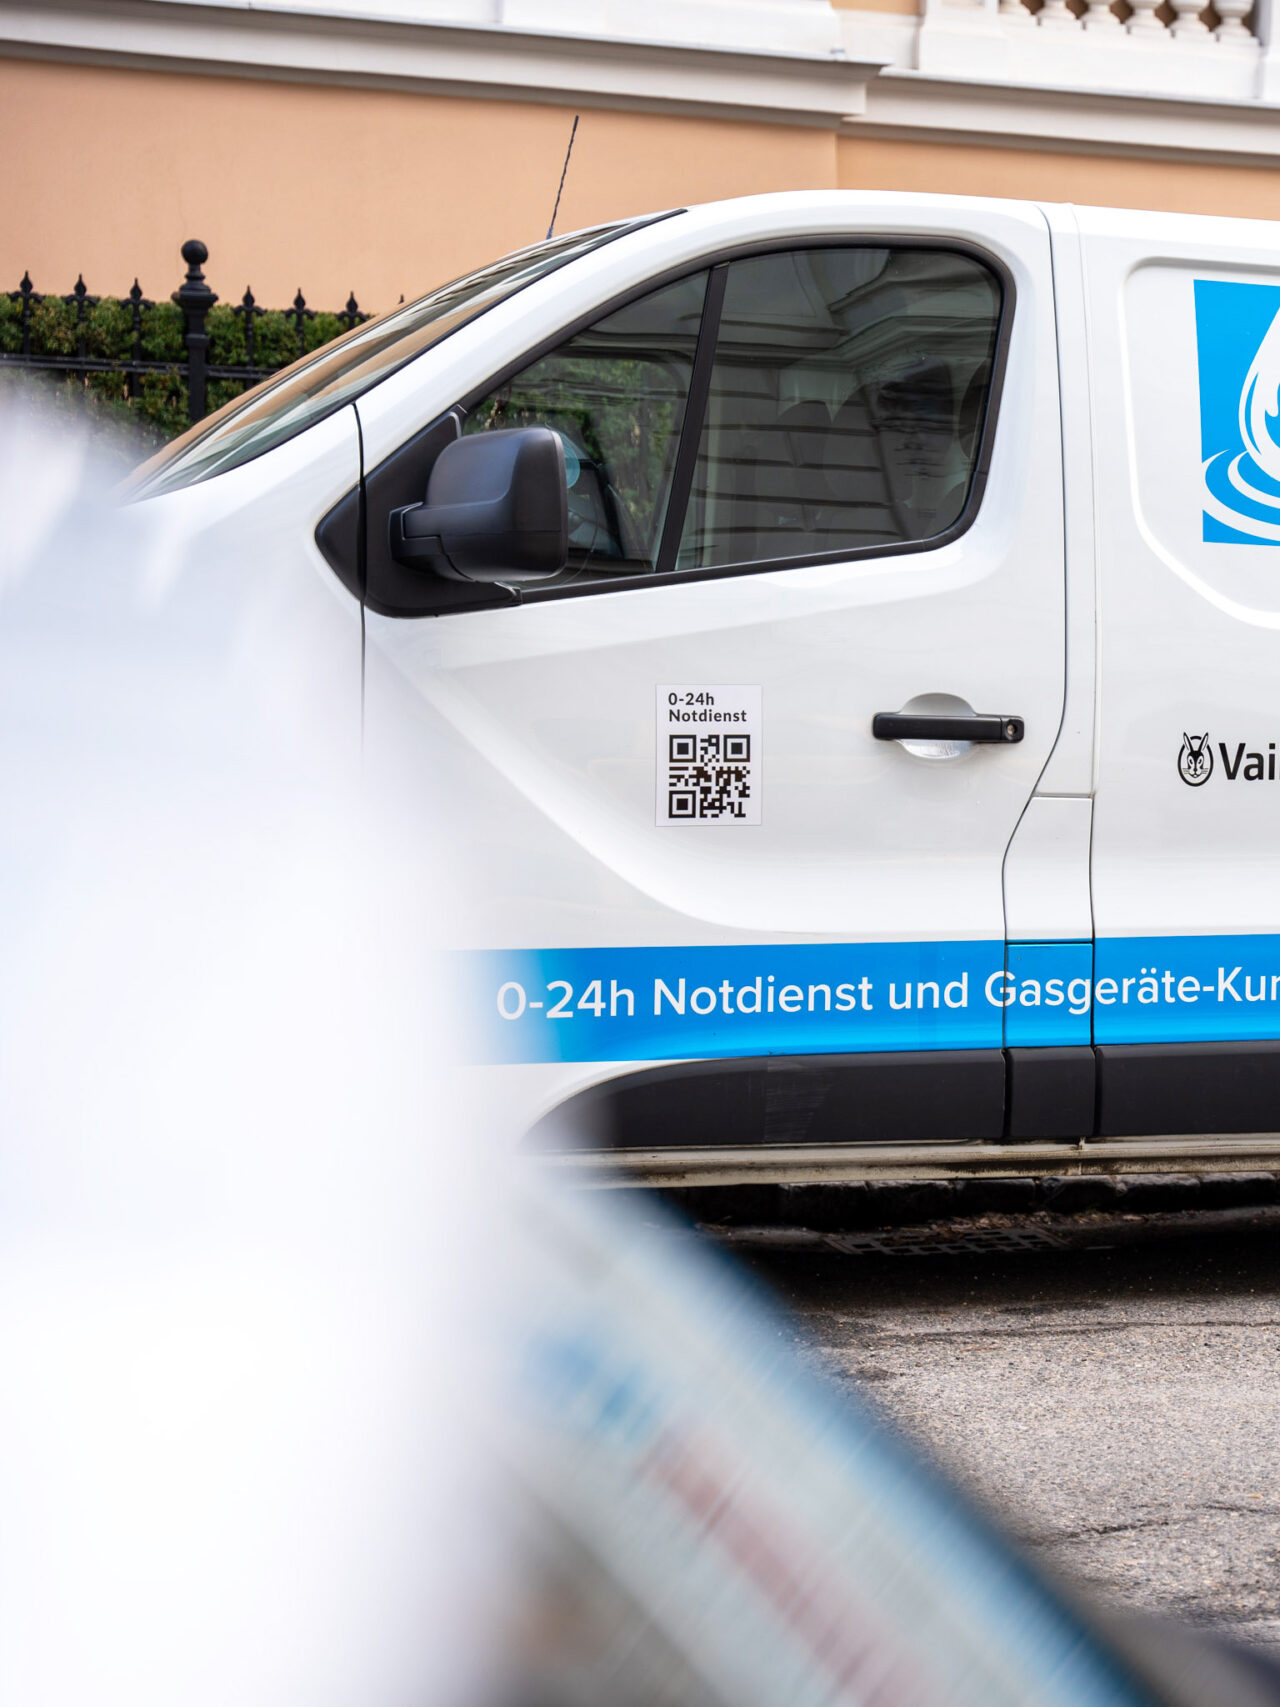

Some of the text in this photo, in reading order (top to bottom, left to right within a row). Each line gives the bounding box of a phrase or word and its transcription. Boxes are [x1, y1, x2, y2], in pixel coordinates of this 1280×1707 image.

[668, 692, 715, 706] 0-24h
[668, 708, 748, 722] Notdienst
[496, 979, 635, 1021] 0-24h
[654, 975, 873, 1016] Notdienst
[889, 972, 968, 1010] und
